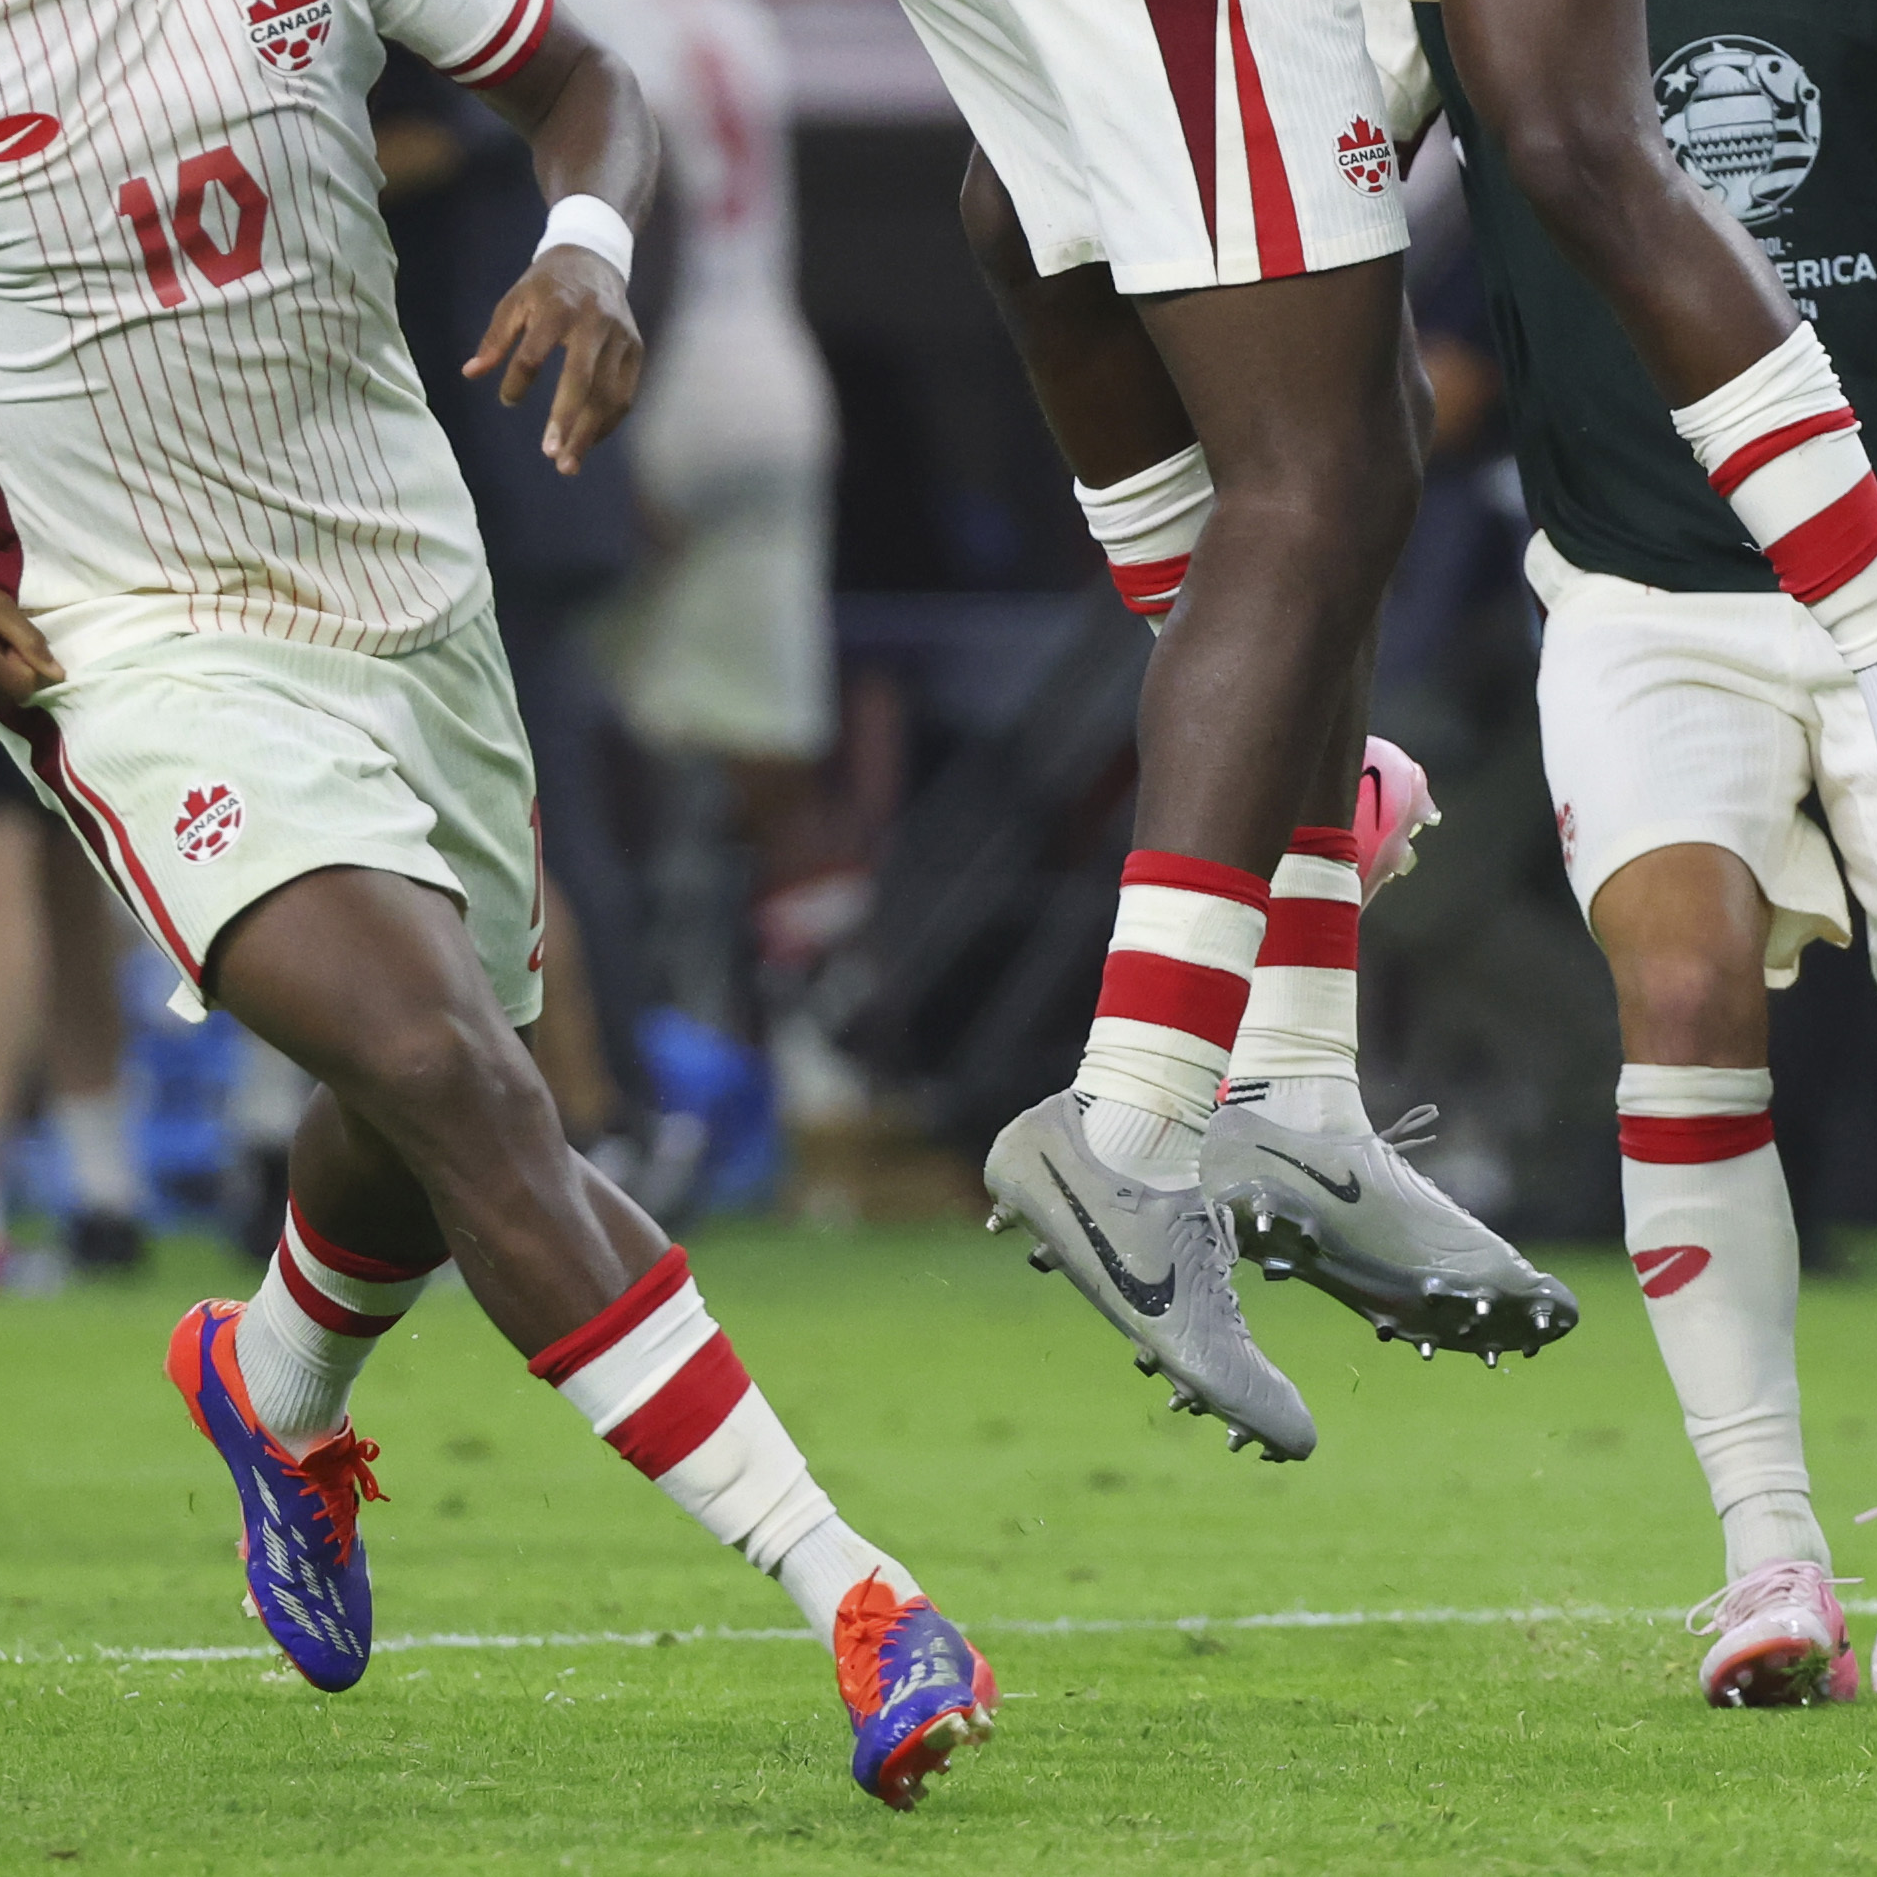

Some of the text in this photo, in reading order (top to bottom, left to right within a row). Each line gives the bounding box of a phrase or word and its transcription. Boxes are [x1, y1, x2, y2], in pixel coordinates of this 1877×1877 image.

[250, 2, 332, 43] CANADA
[1338, 146, 1391, 166] CANADA
[119, 145, 268, 309] 10
[1776, 252, 1877, 291] ERICA
[177, 797, 240, 851] CANADA
